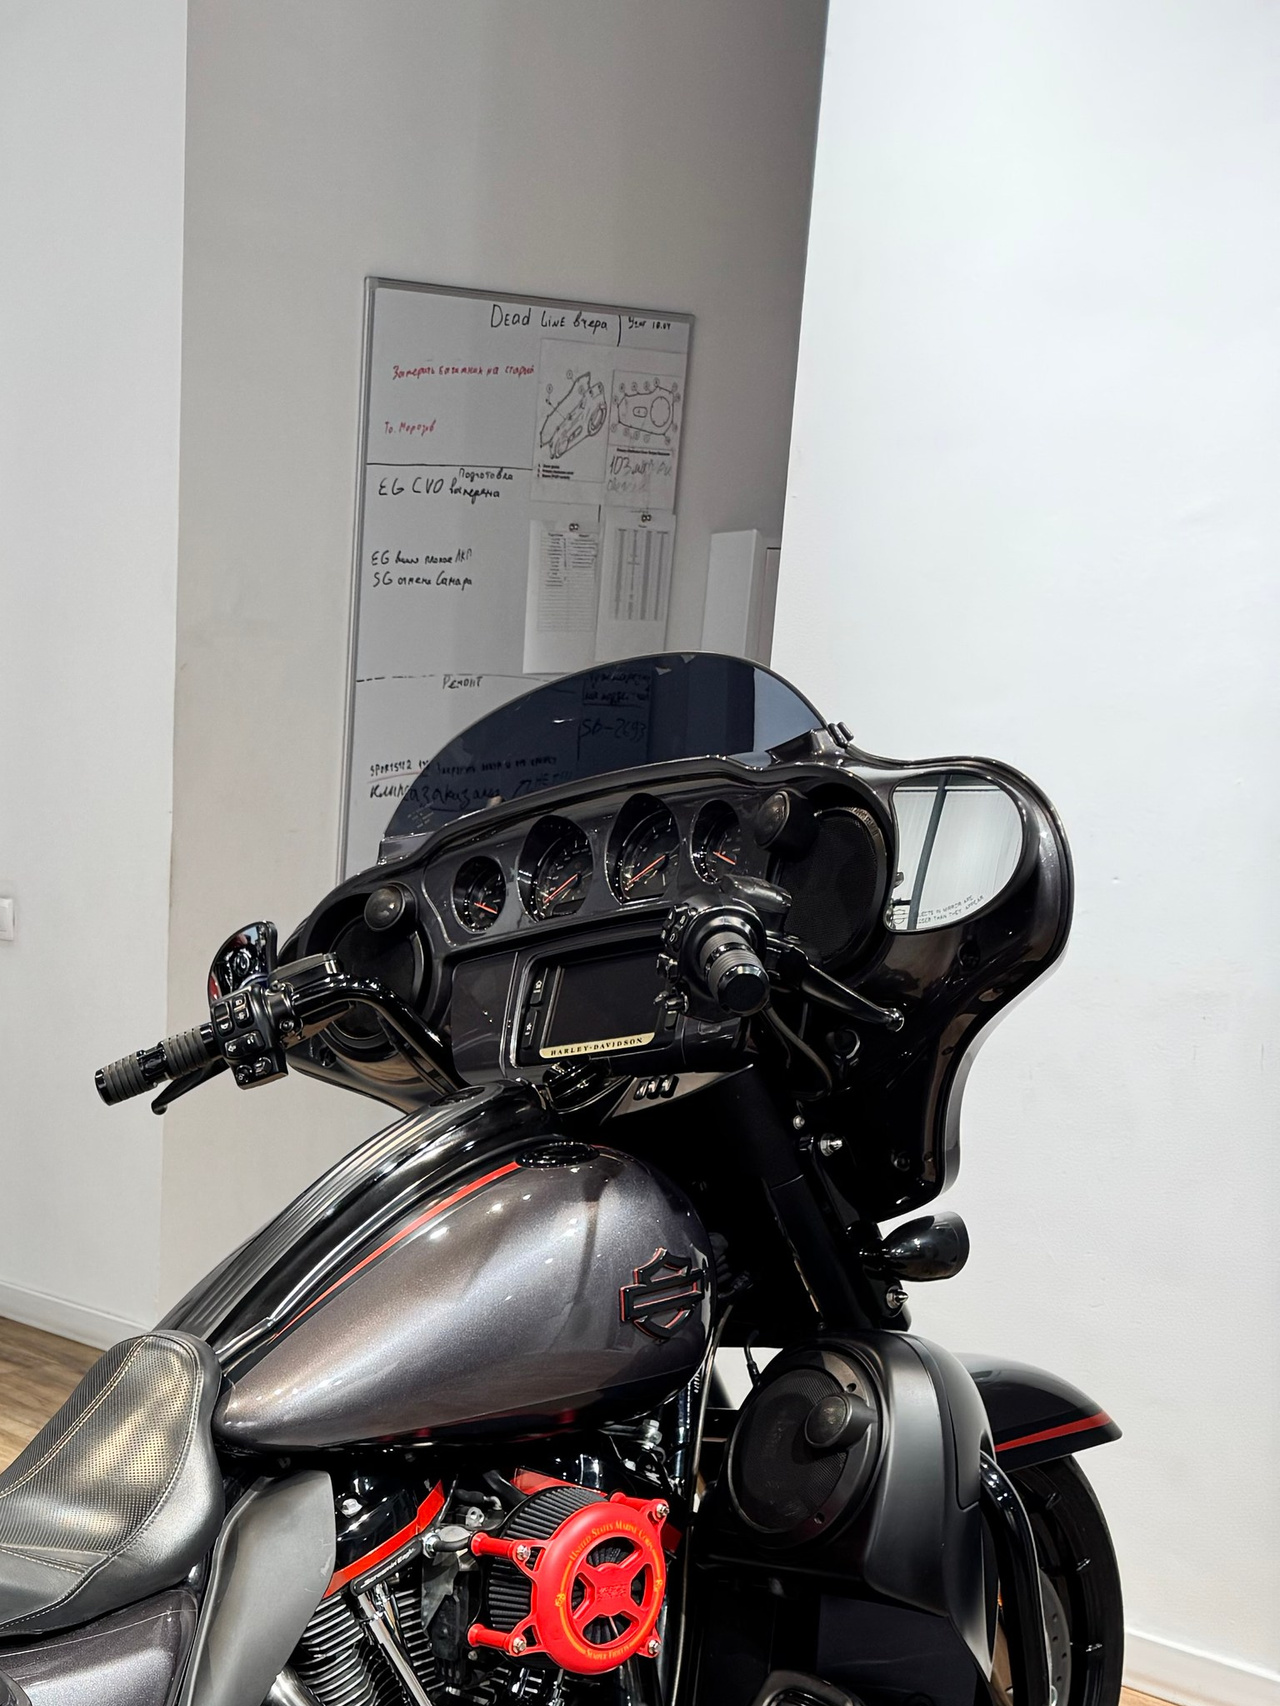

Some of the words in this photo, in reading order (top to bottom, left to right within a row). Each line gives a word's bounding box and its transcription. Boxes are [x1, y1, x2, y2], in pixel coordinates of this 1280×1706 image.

[378, 477, 405, 496] EG
[412, 477, 445, 494] CVO
[371, 550, 390, 566] EG
[373, 571, 393, 588] SG
